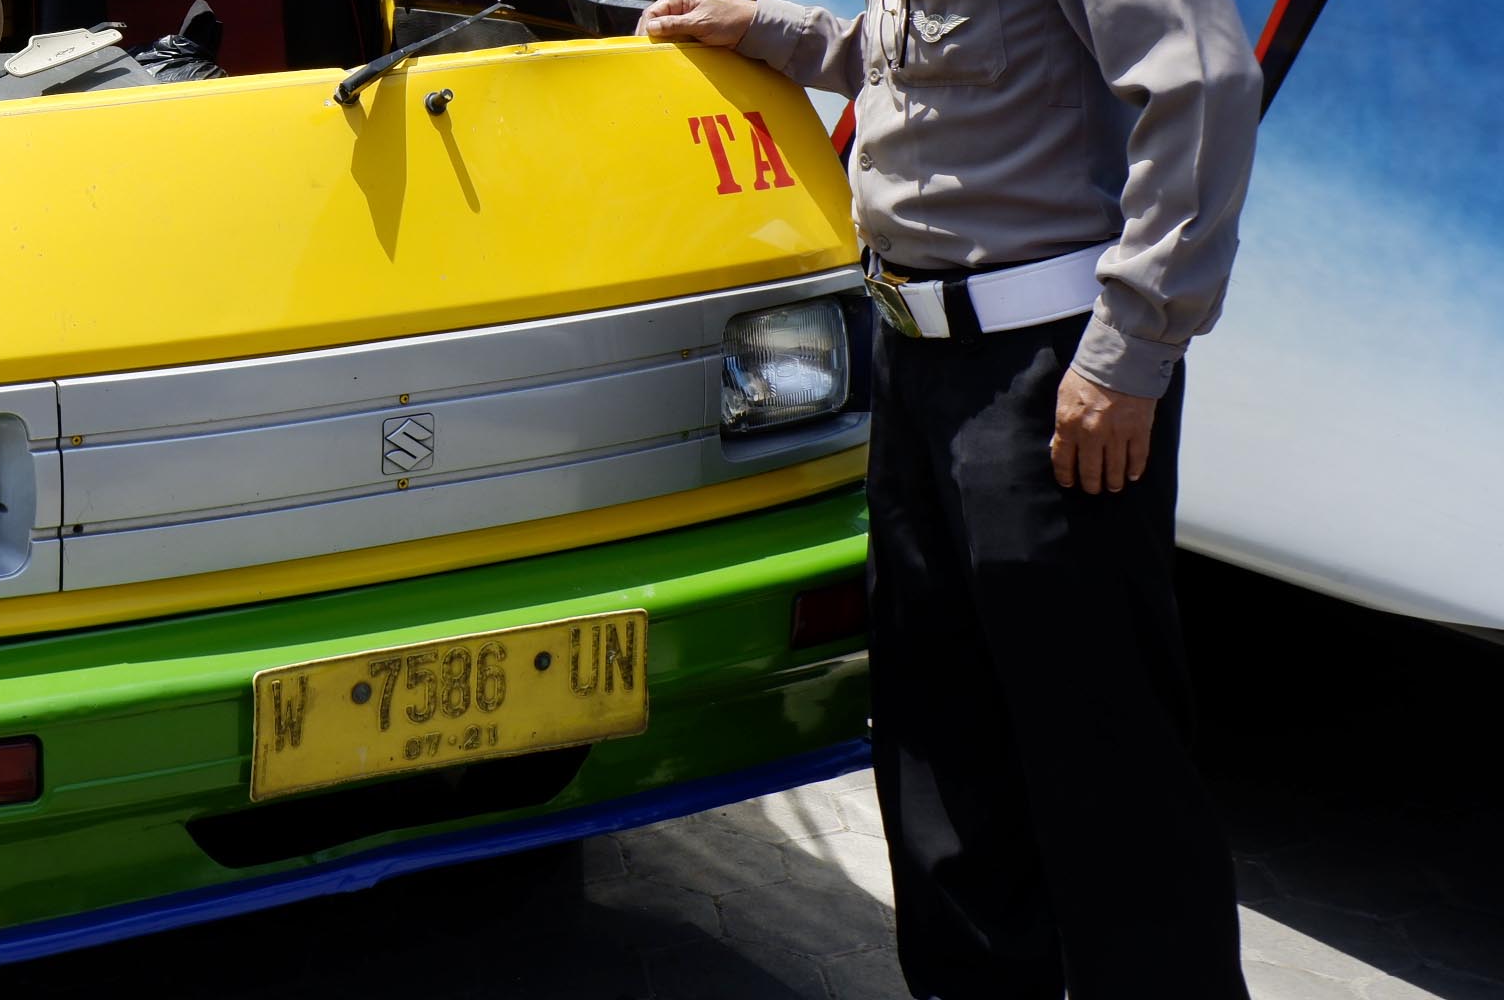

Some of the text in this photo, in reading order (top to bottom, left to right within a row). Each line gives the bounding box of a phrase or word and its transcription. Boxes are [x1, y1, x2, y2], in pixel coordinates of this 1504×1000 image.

[687, 111, 796, 195] TA
[271, 620, 637, 753] W 7586 UN
